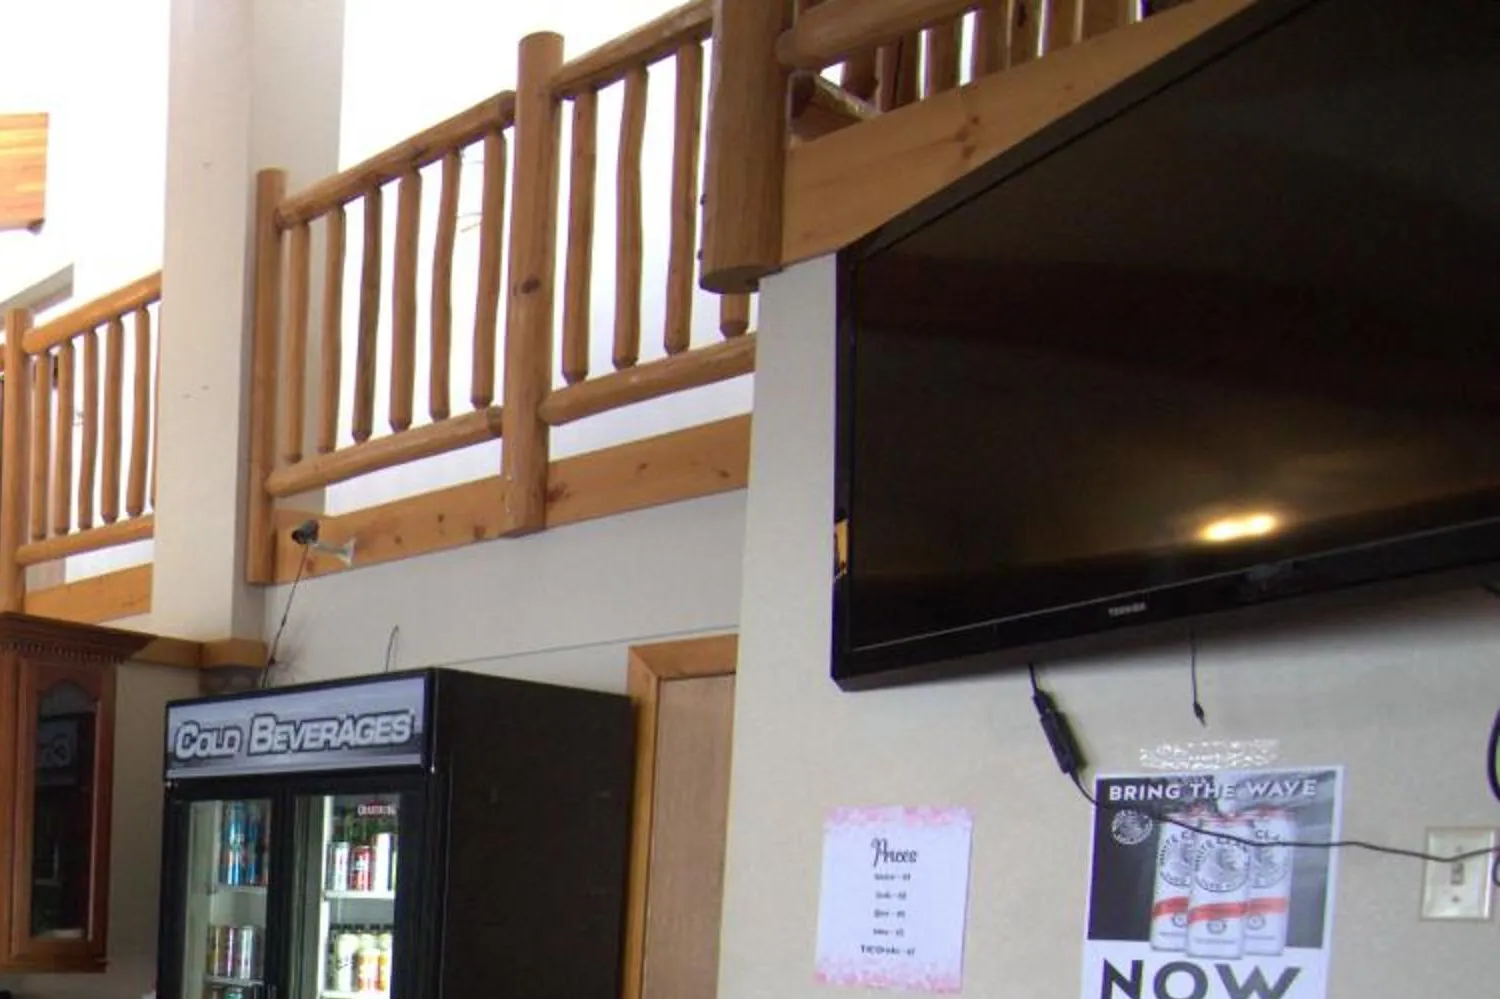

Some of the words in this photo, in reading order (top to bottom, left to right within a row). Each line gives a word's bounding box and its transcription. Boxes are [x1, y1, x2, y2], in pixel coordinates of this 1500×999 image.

[248, 712, 415, 755] BEVERAGES
[1109, 783, 1181, 801] BRING
[1189, 782, 1236, 800] THE
[1247, 779, 1317, 798] WAVE
